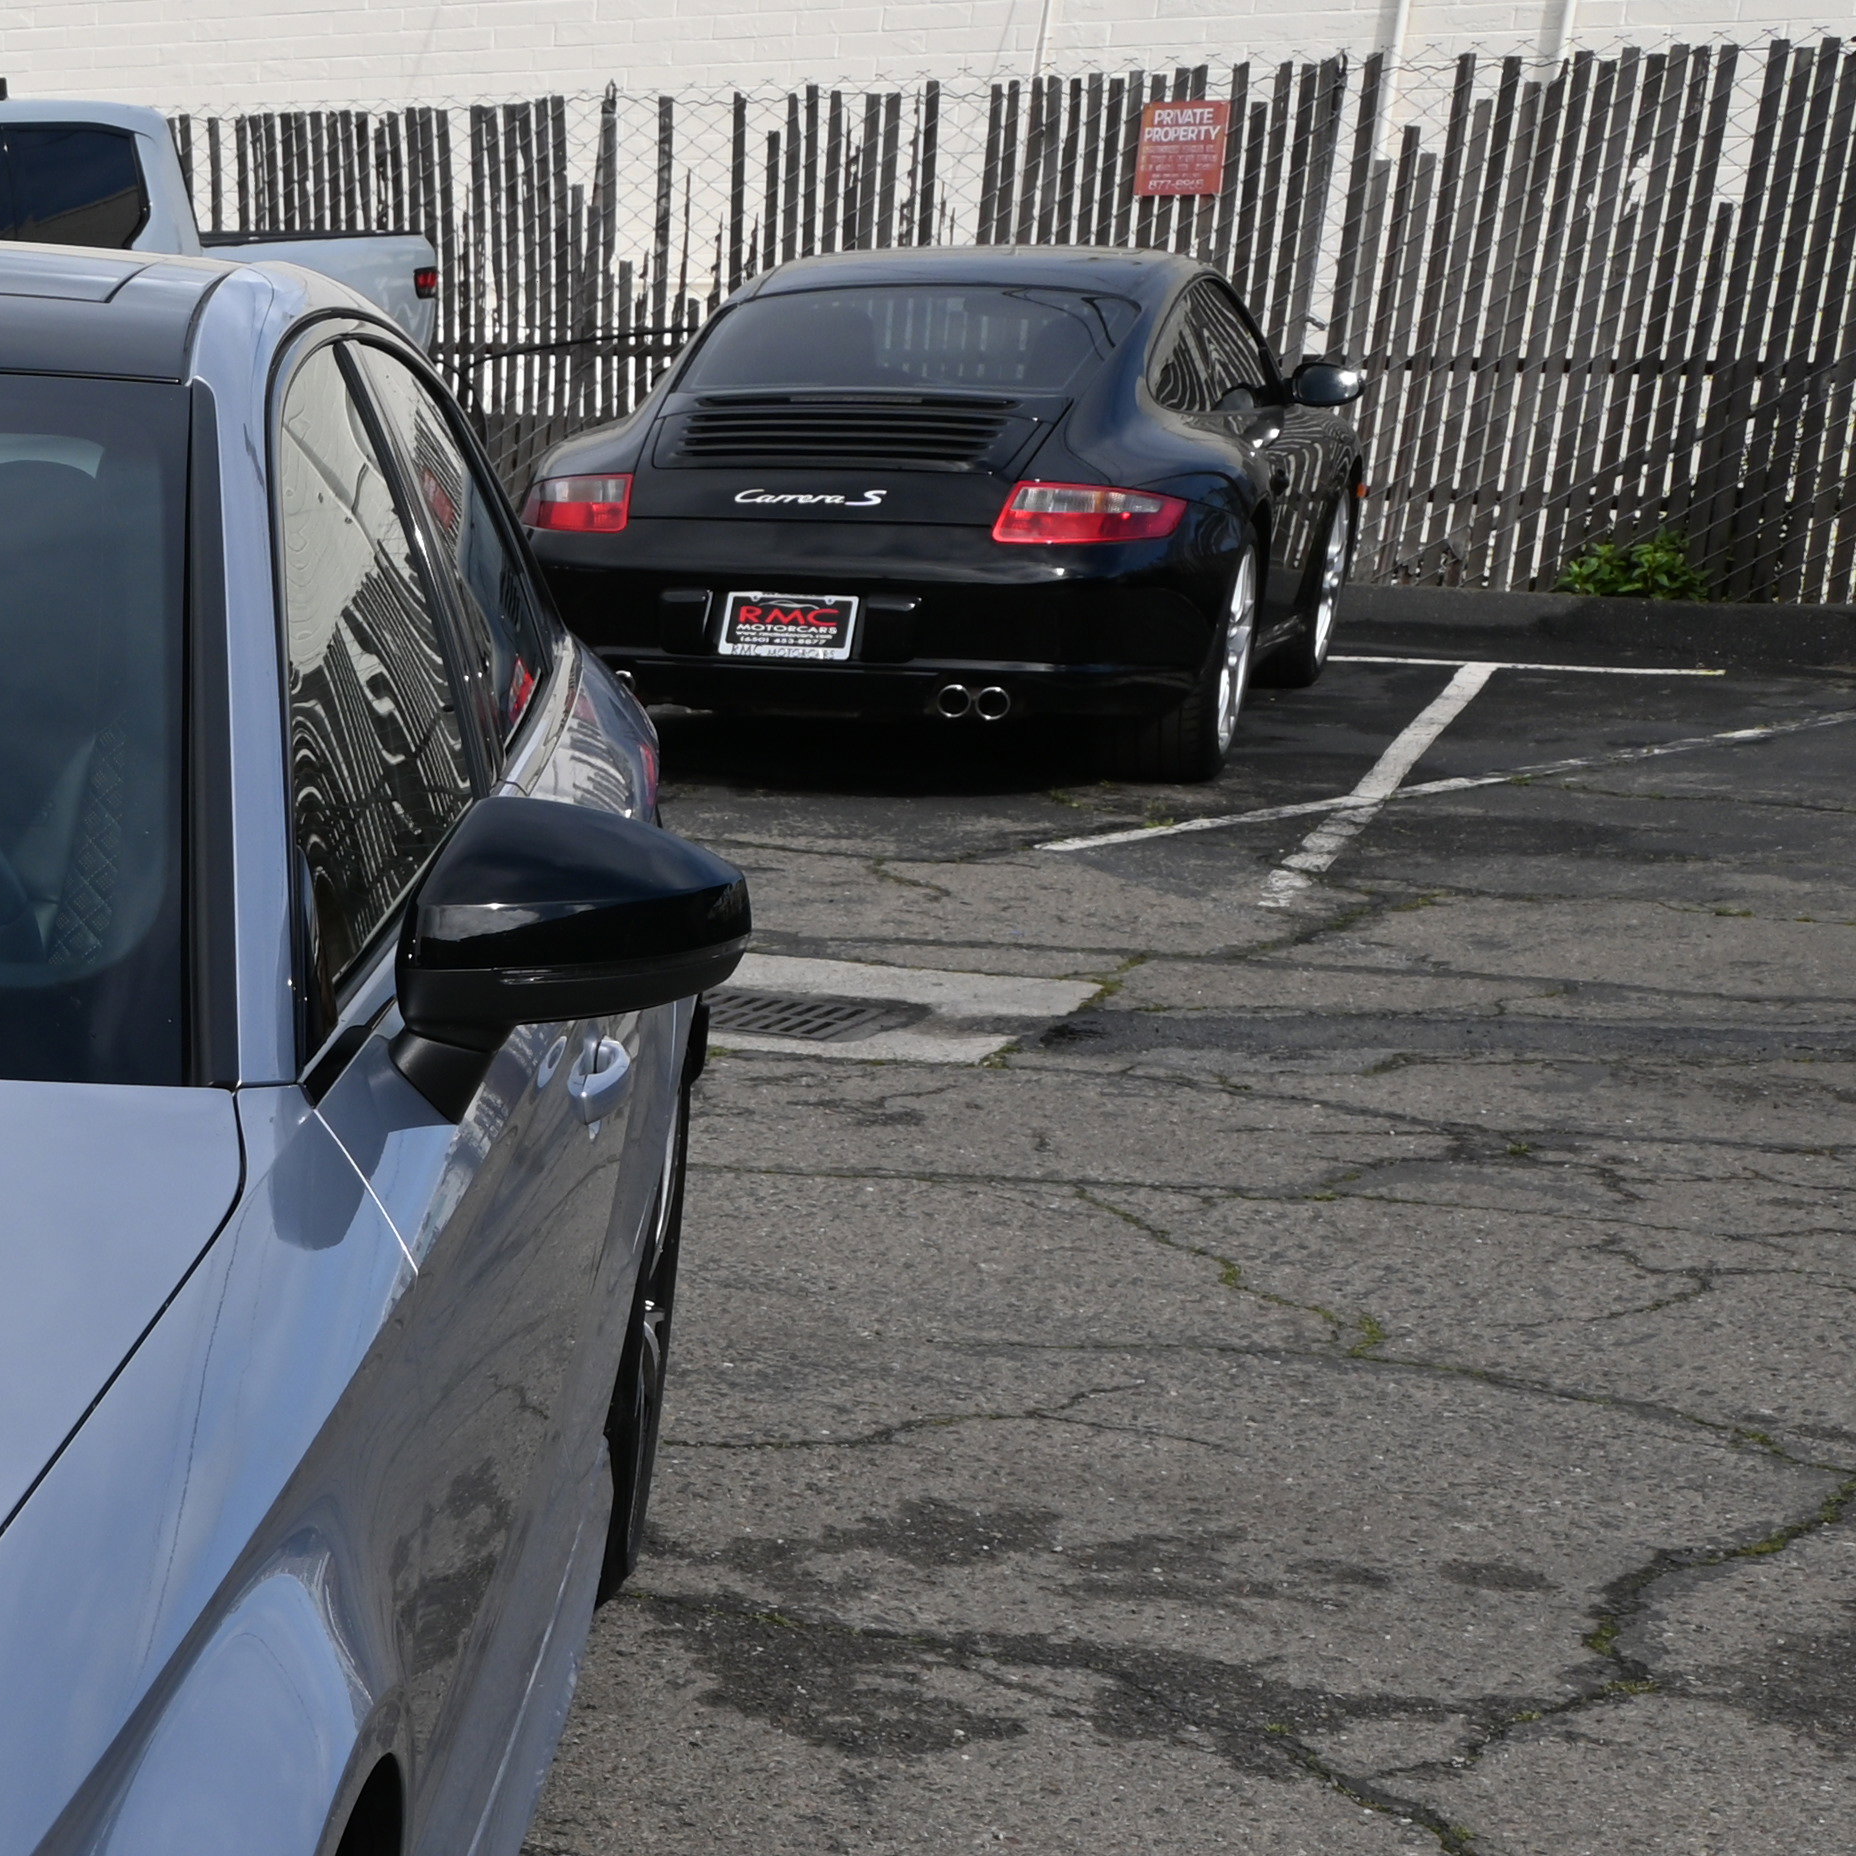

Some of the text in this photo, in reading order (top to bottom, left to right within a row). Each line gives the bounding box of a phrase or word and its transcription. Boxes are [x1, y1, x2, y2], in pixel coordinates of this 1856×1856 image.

[1154, 108, 1214, 125] PRIVATE
[1143, 126, 1221, 142] PROPERTY
[734, 488, 888, 506] Carrera S
[739, 605, 840, 627] RMC
[736, 623, 838, 635] MOTORCARS
